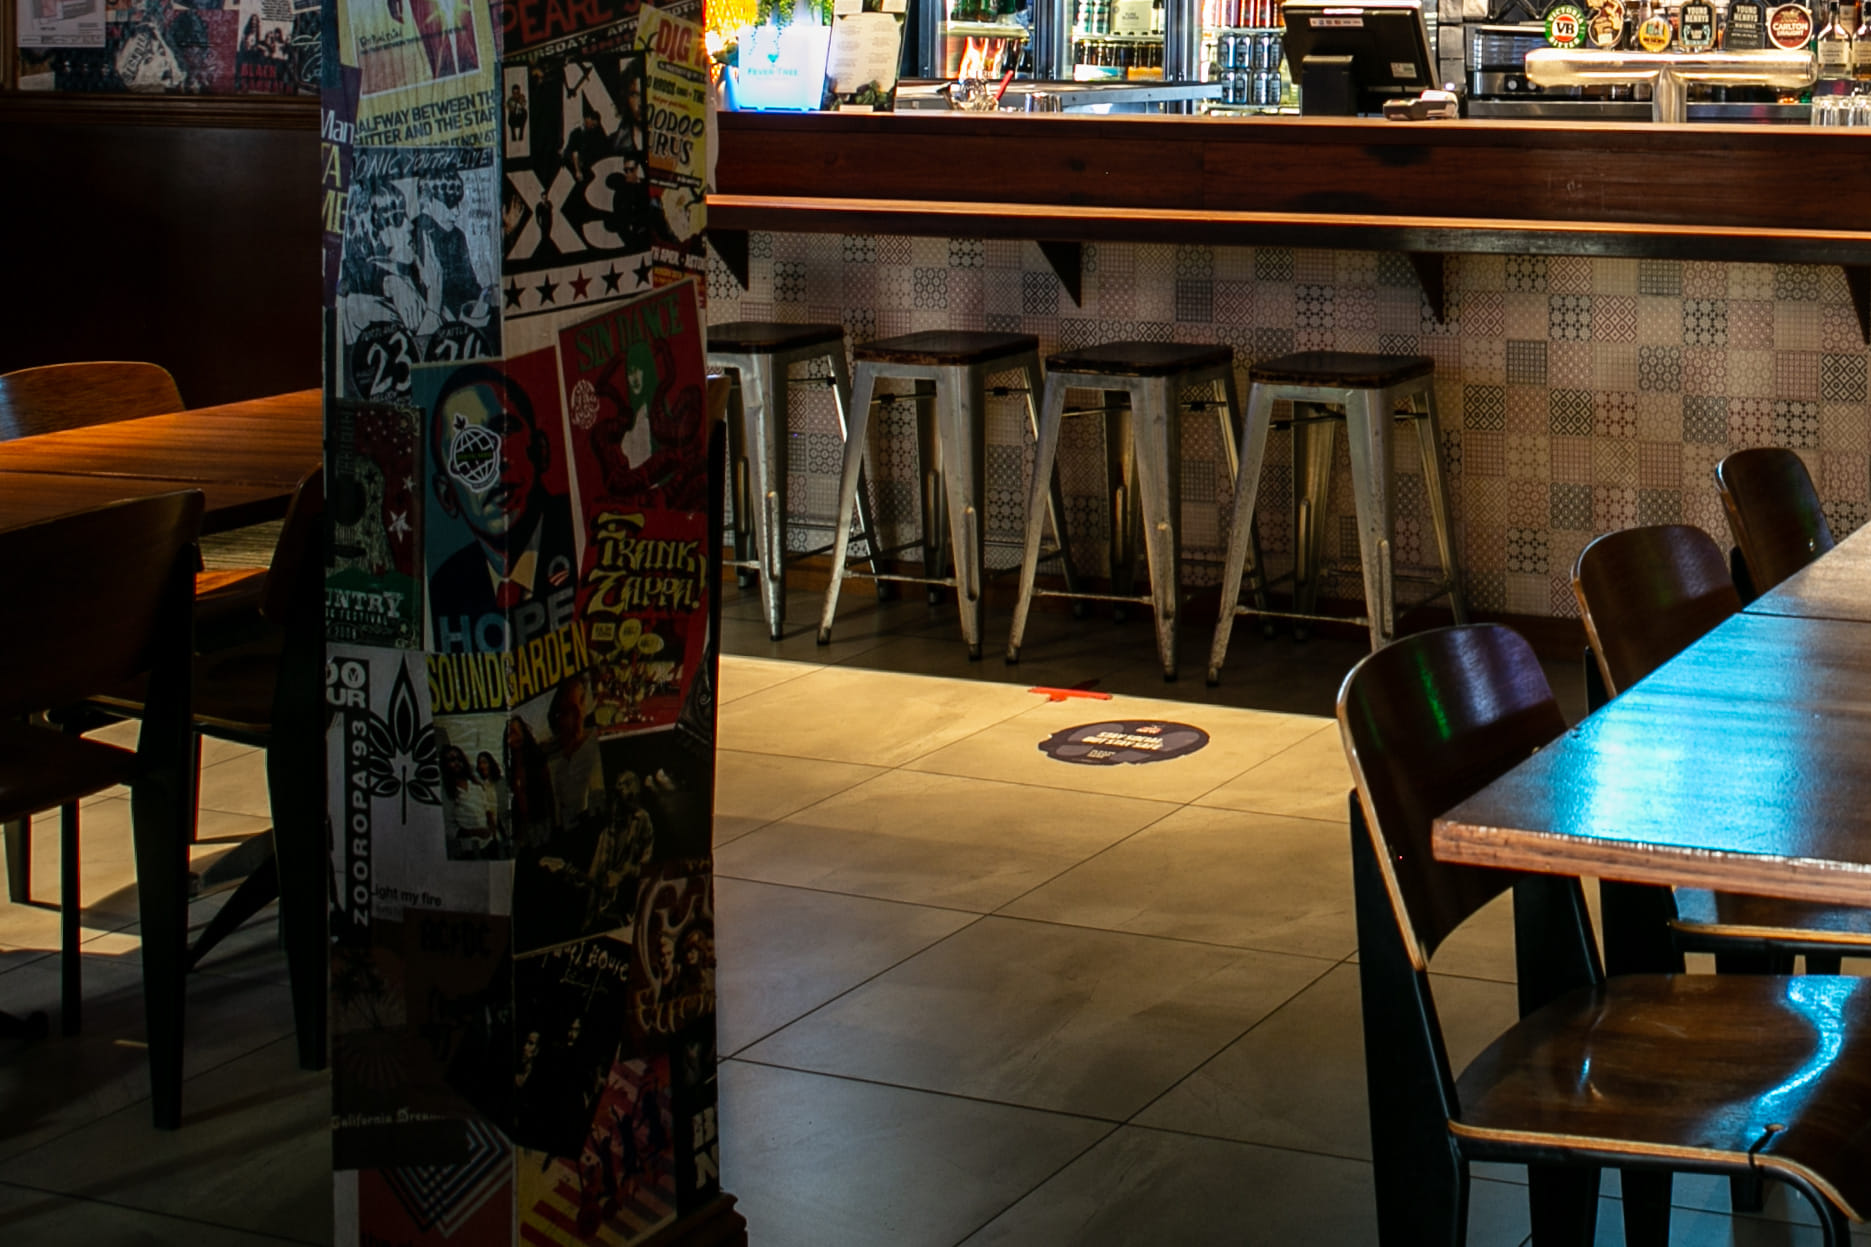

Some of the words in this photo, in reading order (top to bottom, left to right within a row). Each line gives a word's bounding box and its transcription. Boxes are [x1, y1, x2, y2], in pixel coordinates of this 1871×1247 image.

[1548, 7, 1584, 25] VICTORIA
[1556, 22, 1575, 34] VB
[1772, 23, 1809, 31] CARLTON
[656, 19, 692, 63] DIG
[413, 93, 475, 120] BETWEEN
[405, 121, 432, 139] AND
[435, 114, 462, 131] THE
[367, 331, 412, 395] 23
[438, 587, 575, 652] HOPE
[426, 619, 589, 714] SOUNDGARDEN
[401, 891, 418, 905] my
[422, 892, 442, 906] fire
